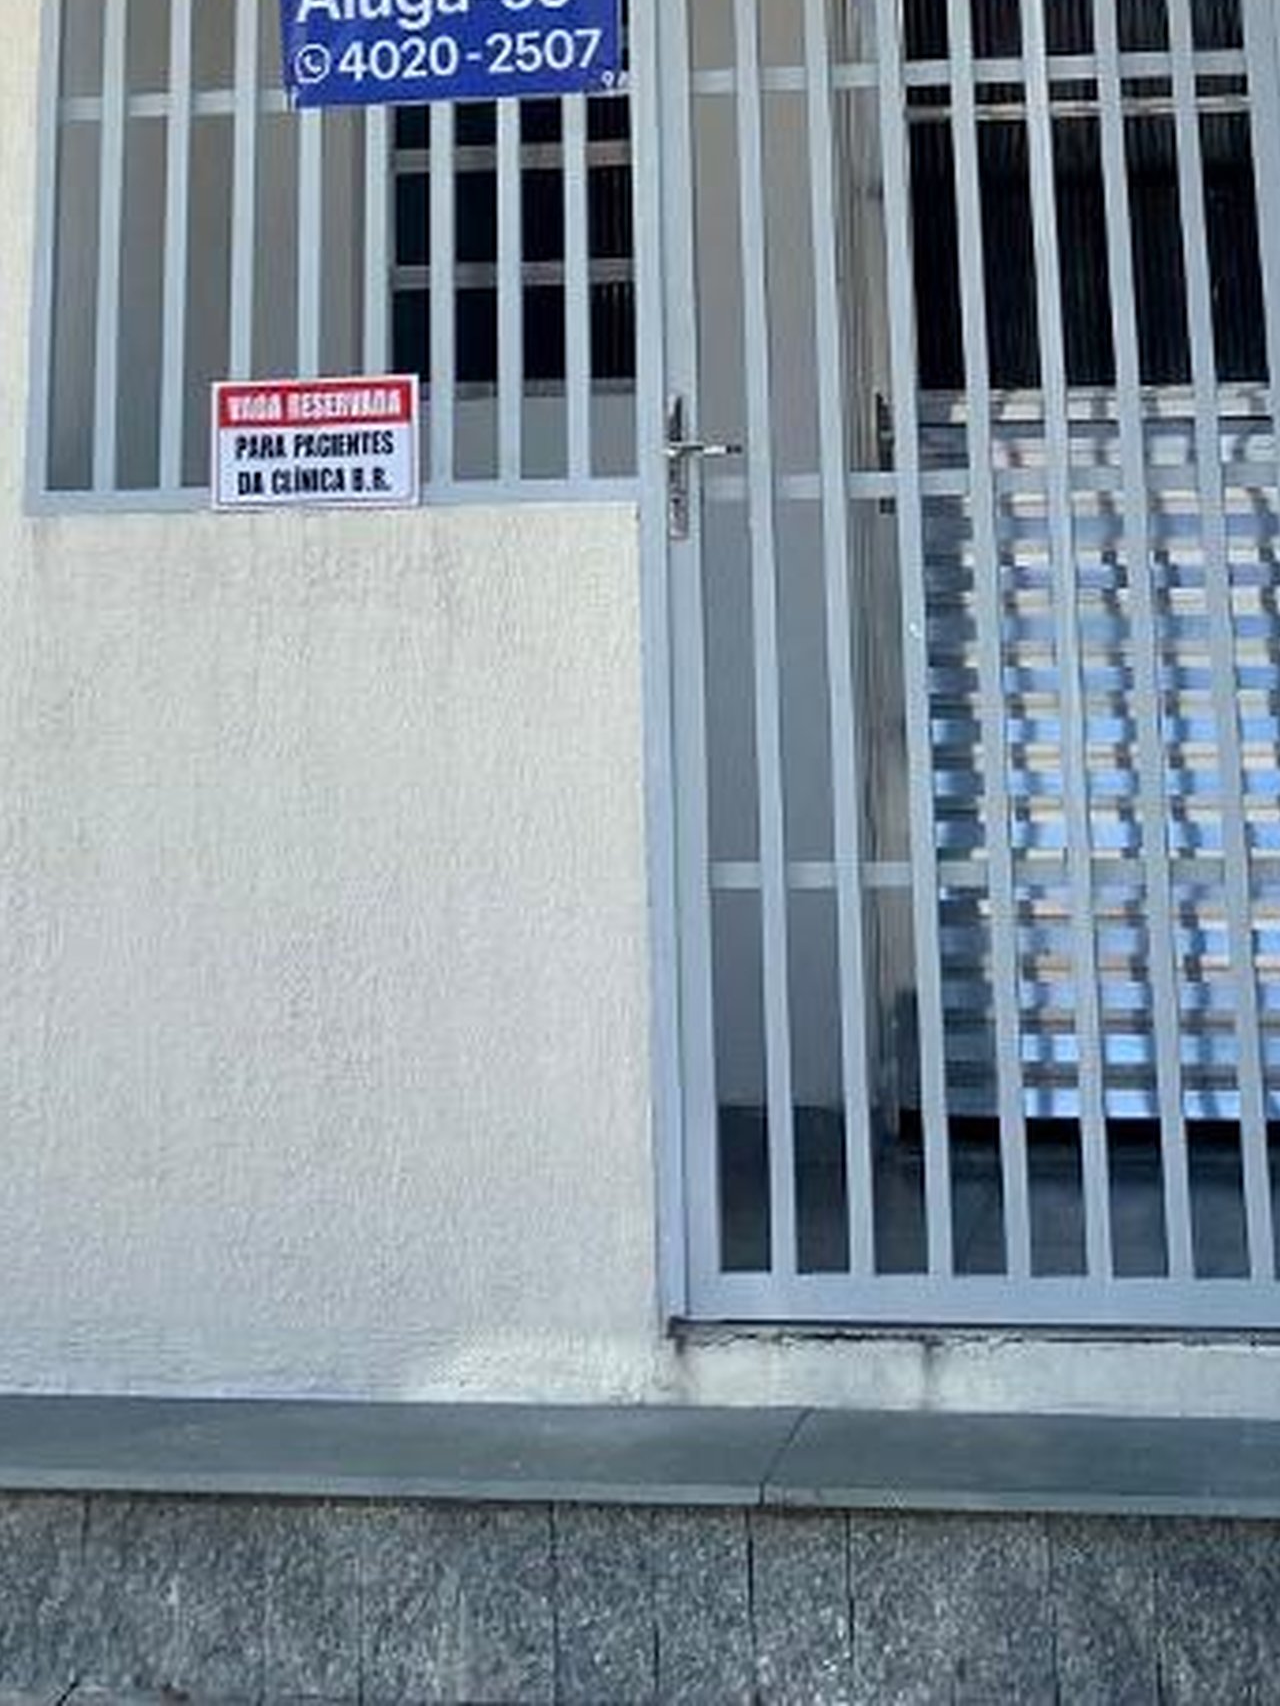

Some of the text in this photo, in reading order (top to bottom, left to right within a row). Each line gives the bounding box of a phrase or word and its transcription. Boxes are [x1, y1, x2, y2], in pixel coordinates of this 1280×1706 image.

[339, 29, 601, 81] 4020-2507
[235, 430, 394, 460] PARA PACIENTES
[237, 471, 265, 495] DA
